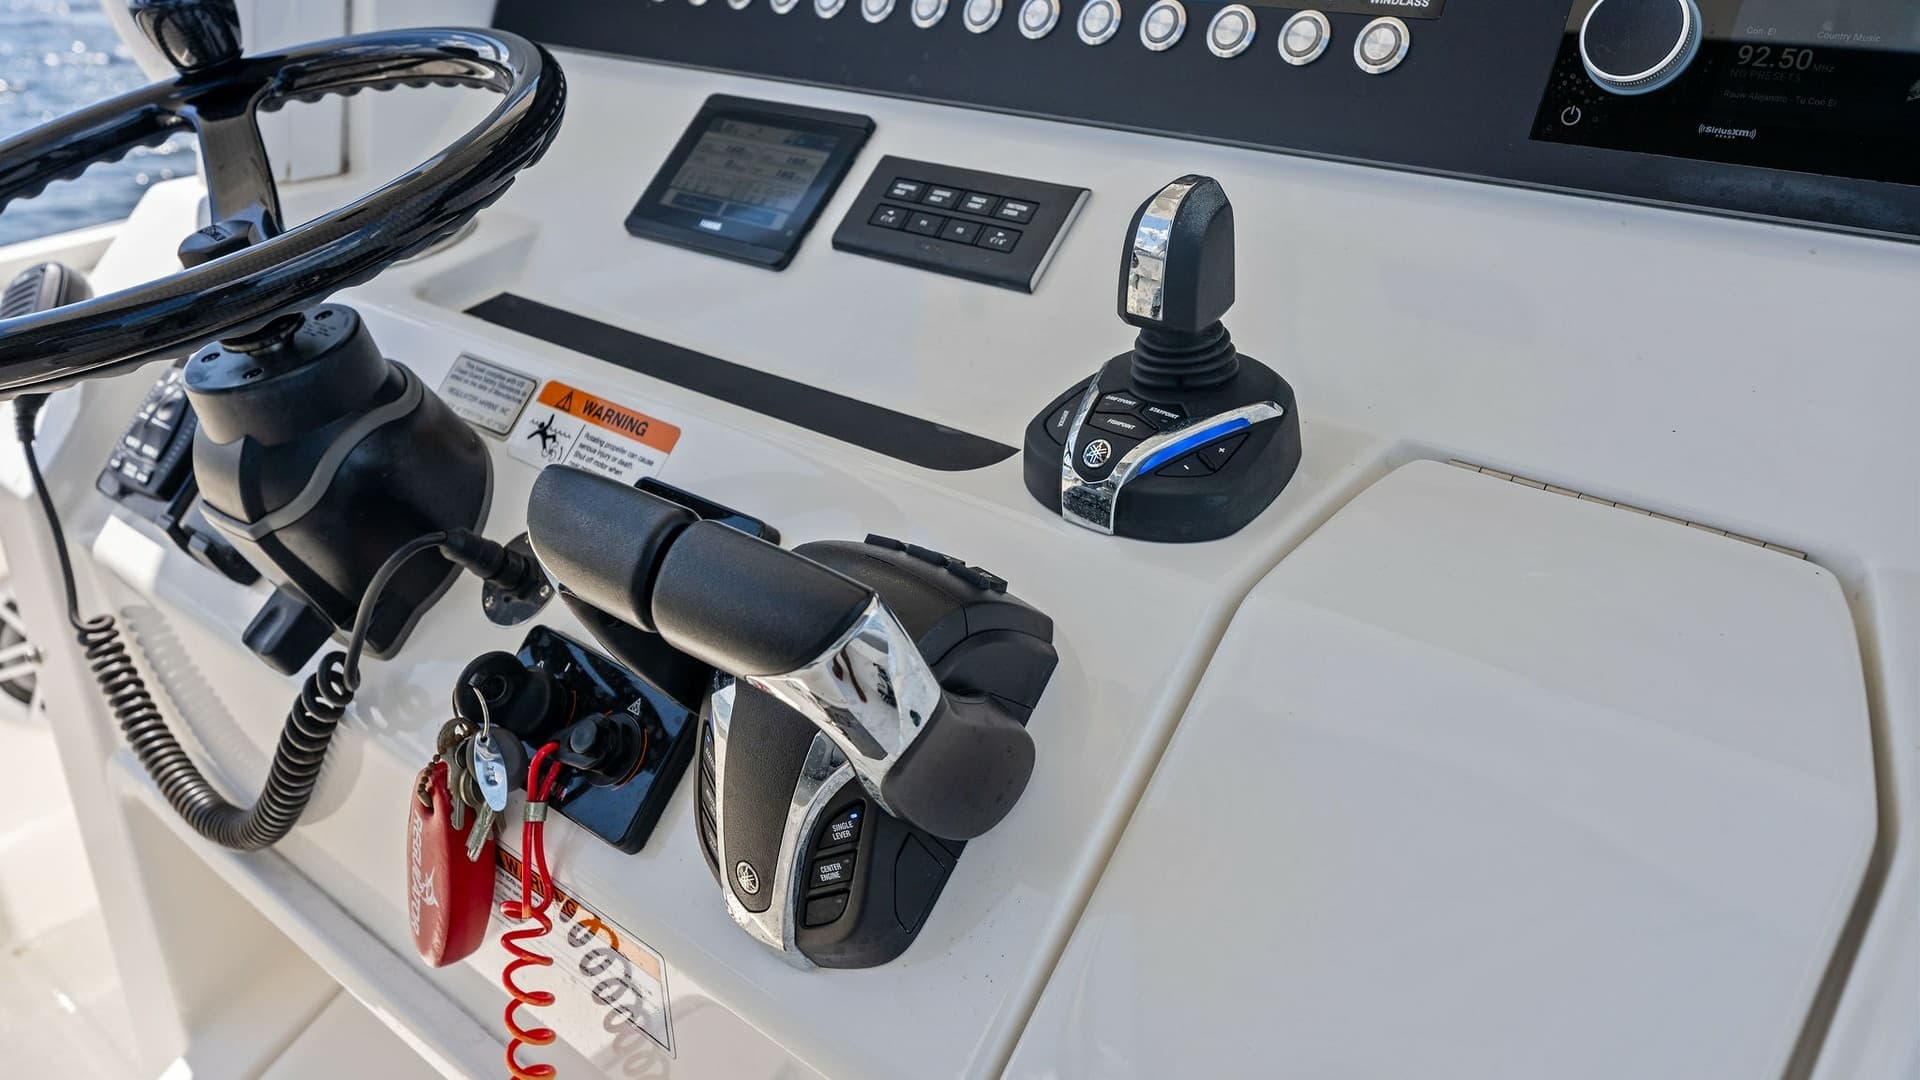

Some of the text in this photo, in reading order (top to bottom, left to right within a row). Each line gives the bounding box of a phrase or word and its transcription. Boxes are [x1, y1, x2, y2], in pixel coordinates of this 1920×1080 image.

[1817, 31, 1850, 42] Country
[1736, 44, 1815, 71] 92.50
[582, 399, 649, 438] WARNING
[832, 820, 854, 832] SINGLE
[832, 830, 851, 840] LEVER
[820, 863, 842, 873] CENTER
[820, 871, 841, 881] ENGINE
